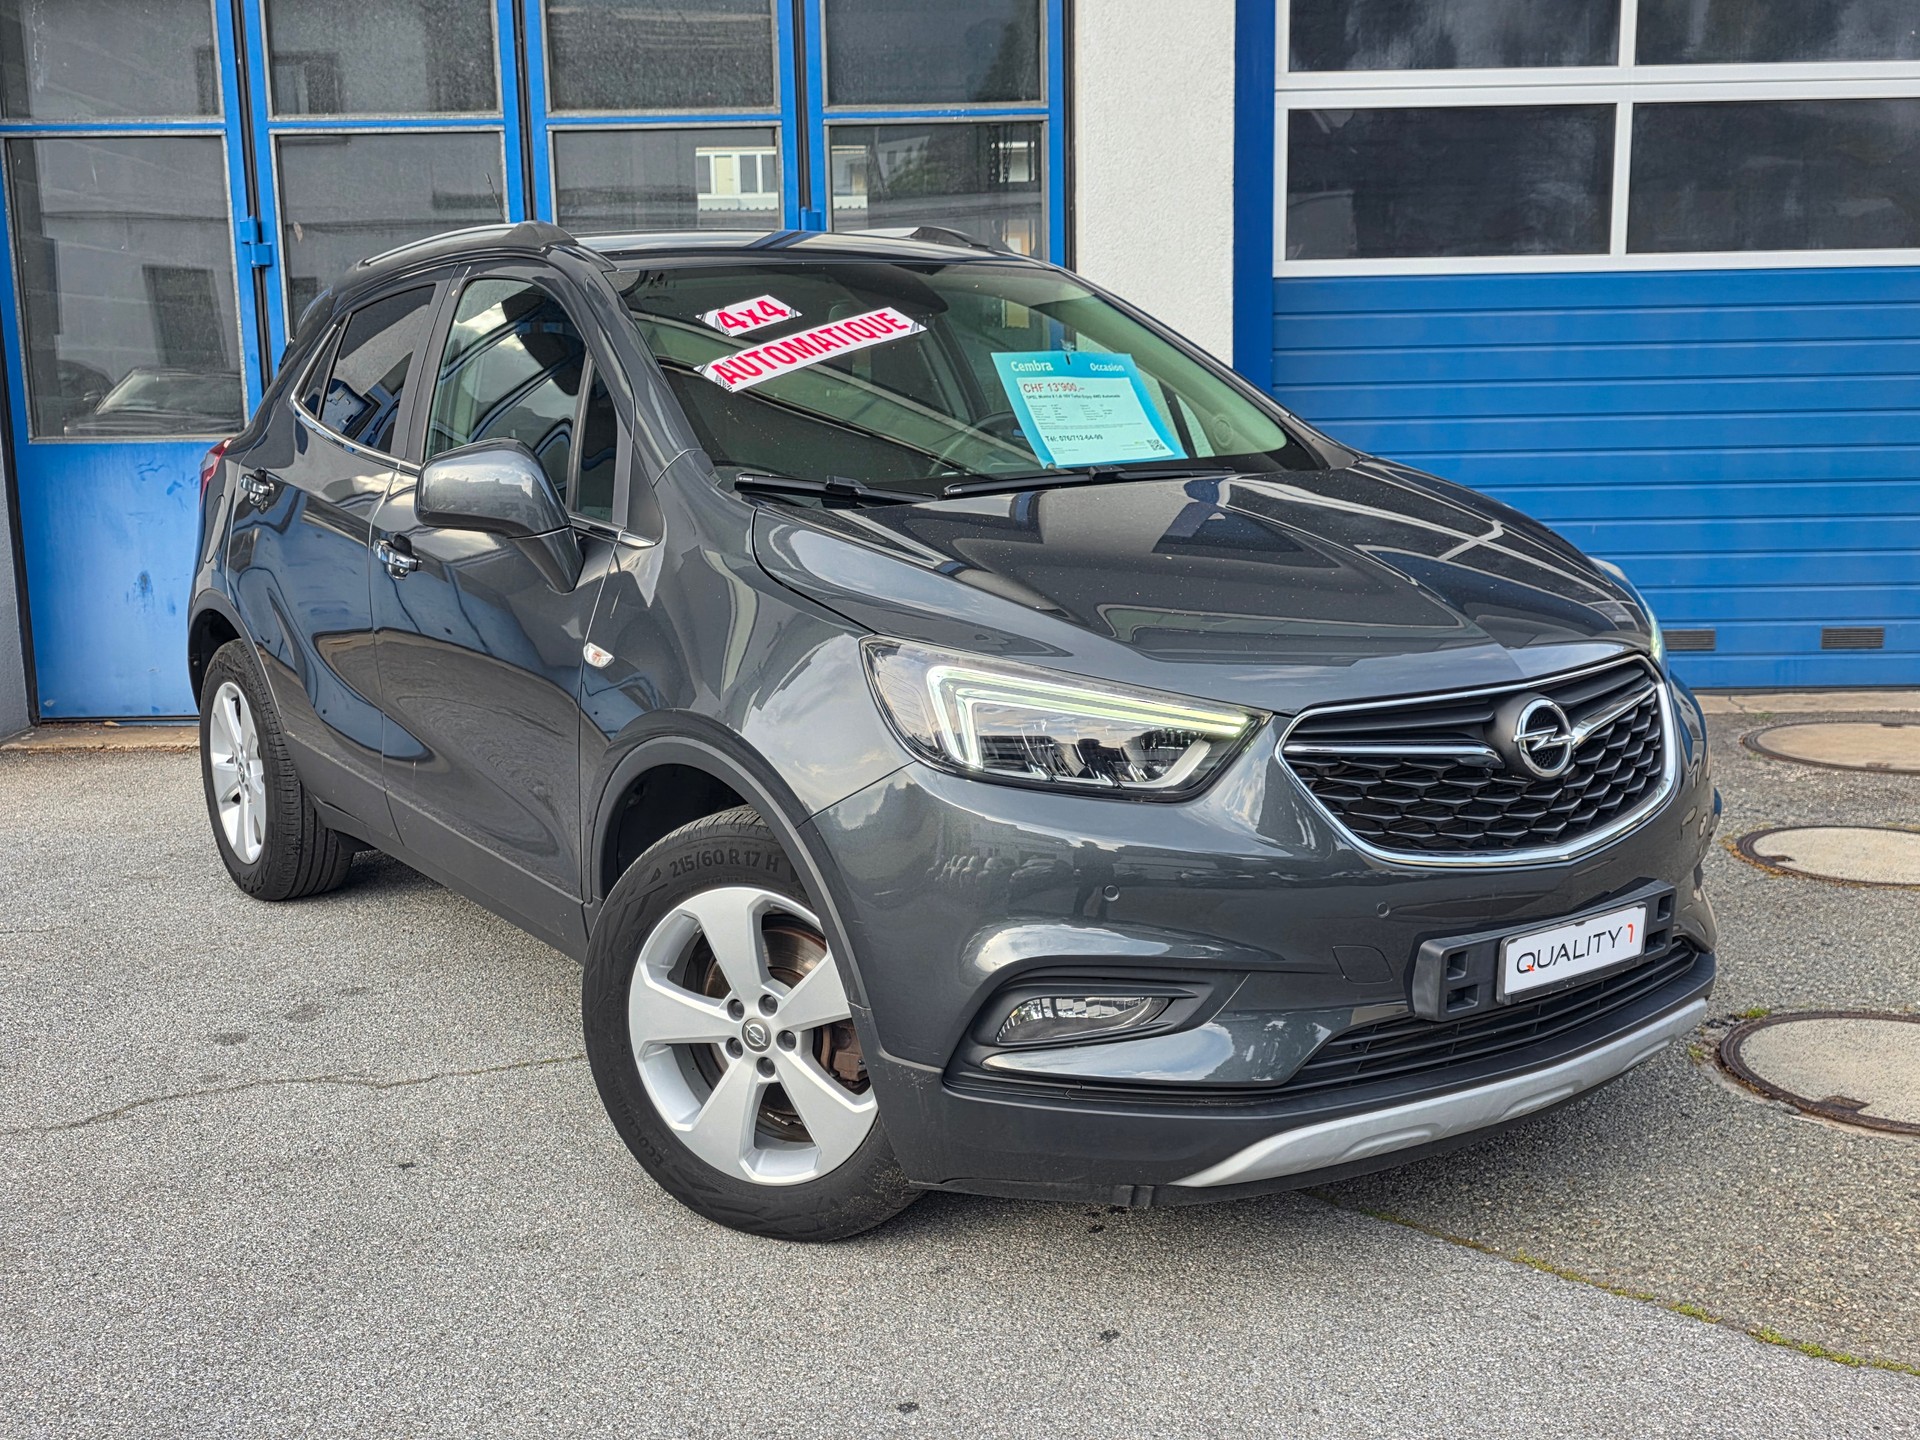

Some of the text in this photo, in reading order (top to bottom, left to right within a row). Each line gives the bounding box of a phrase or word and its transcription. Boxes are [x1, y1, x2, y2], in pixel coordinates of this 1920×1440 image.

[717, 300, 789, 330] 4x4
[711, 312, 910, 385] AUTOMATIQUE
[1010, 360, 1125, 372] Cembra Occasion
[1023, 383, 1044, 393] CHF
[669, 848, 780, 878] 215/60 R 17 H
[1516, 923, 1635, 974] QUALITY 1
